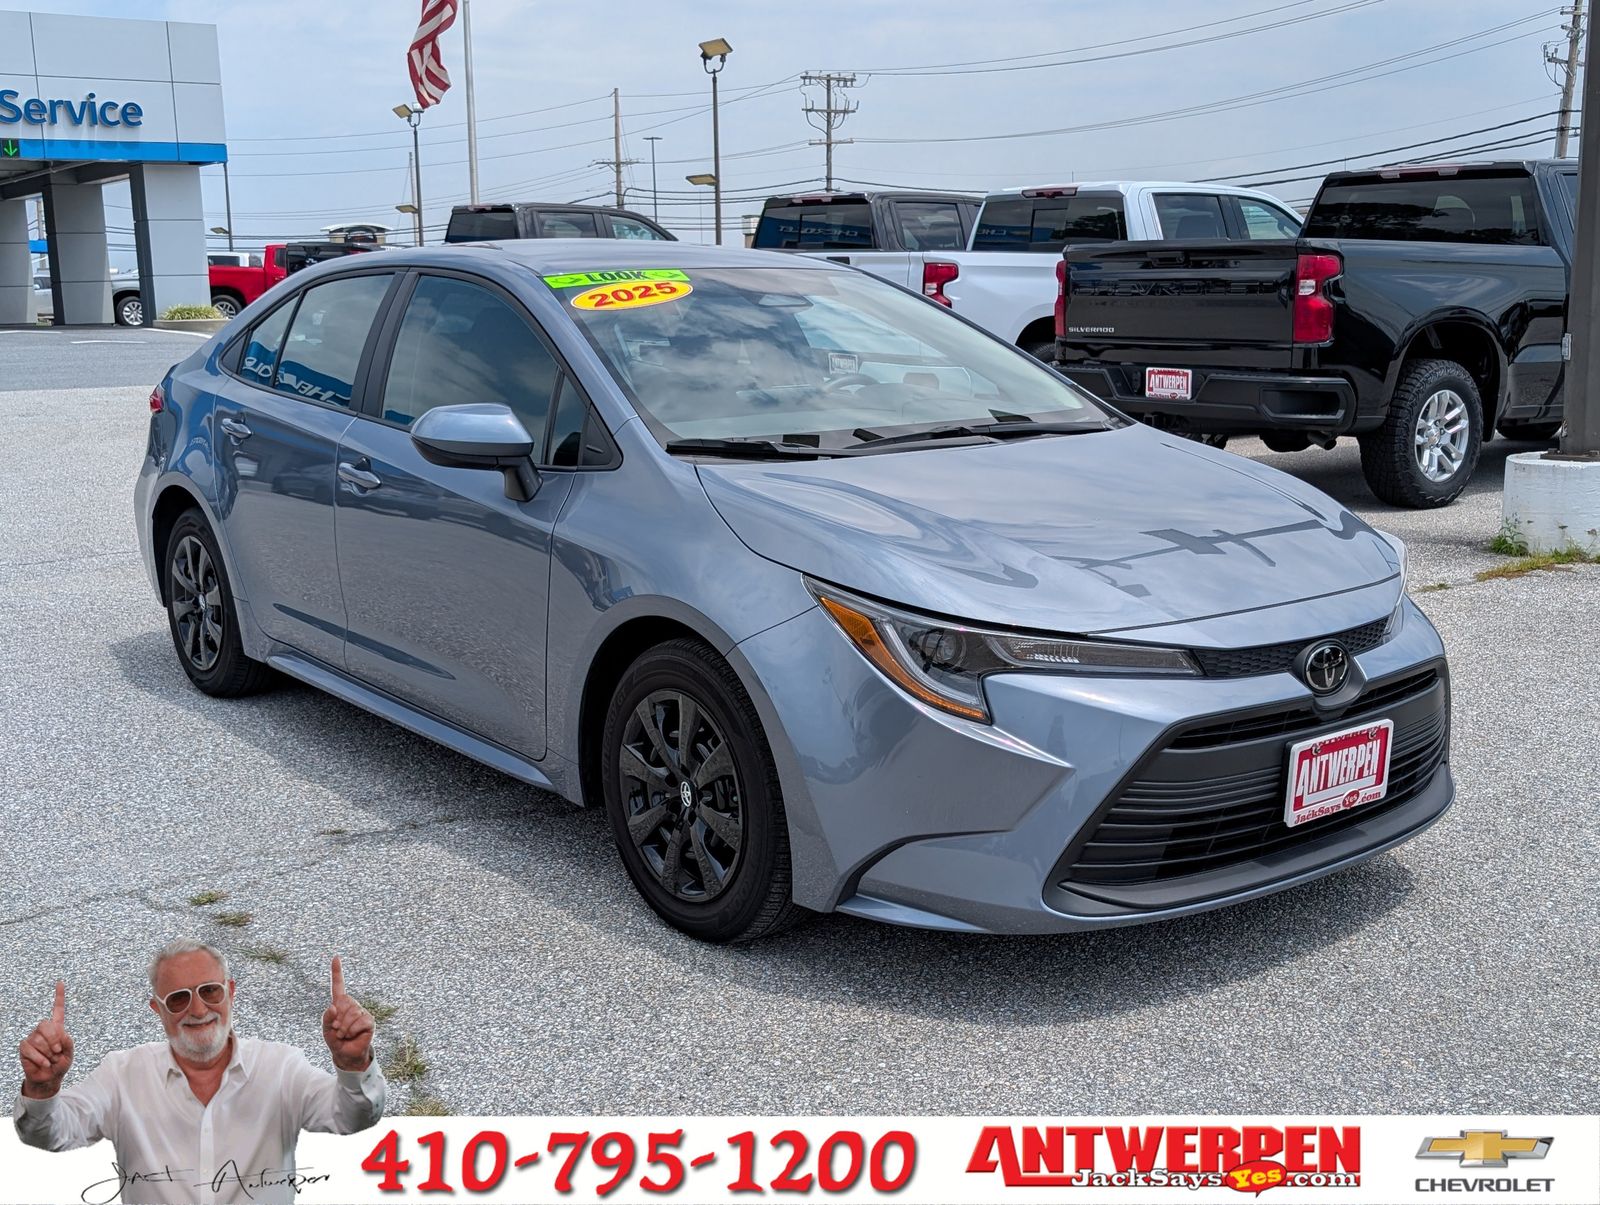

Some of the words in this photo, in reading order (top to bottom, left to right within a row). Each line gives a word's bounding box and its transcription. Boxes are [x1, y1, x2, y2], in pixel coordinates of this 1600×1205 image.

[0, 89, 143, 127] Service
[584, 271, 650, 282] LOOK
[588, 282, 678, 308] 2025
[1150, 374, 1187, 391] ANTWERPEN
[1295, 739, 1381, 799] ANTWERPEN
